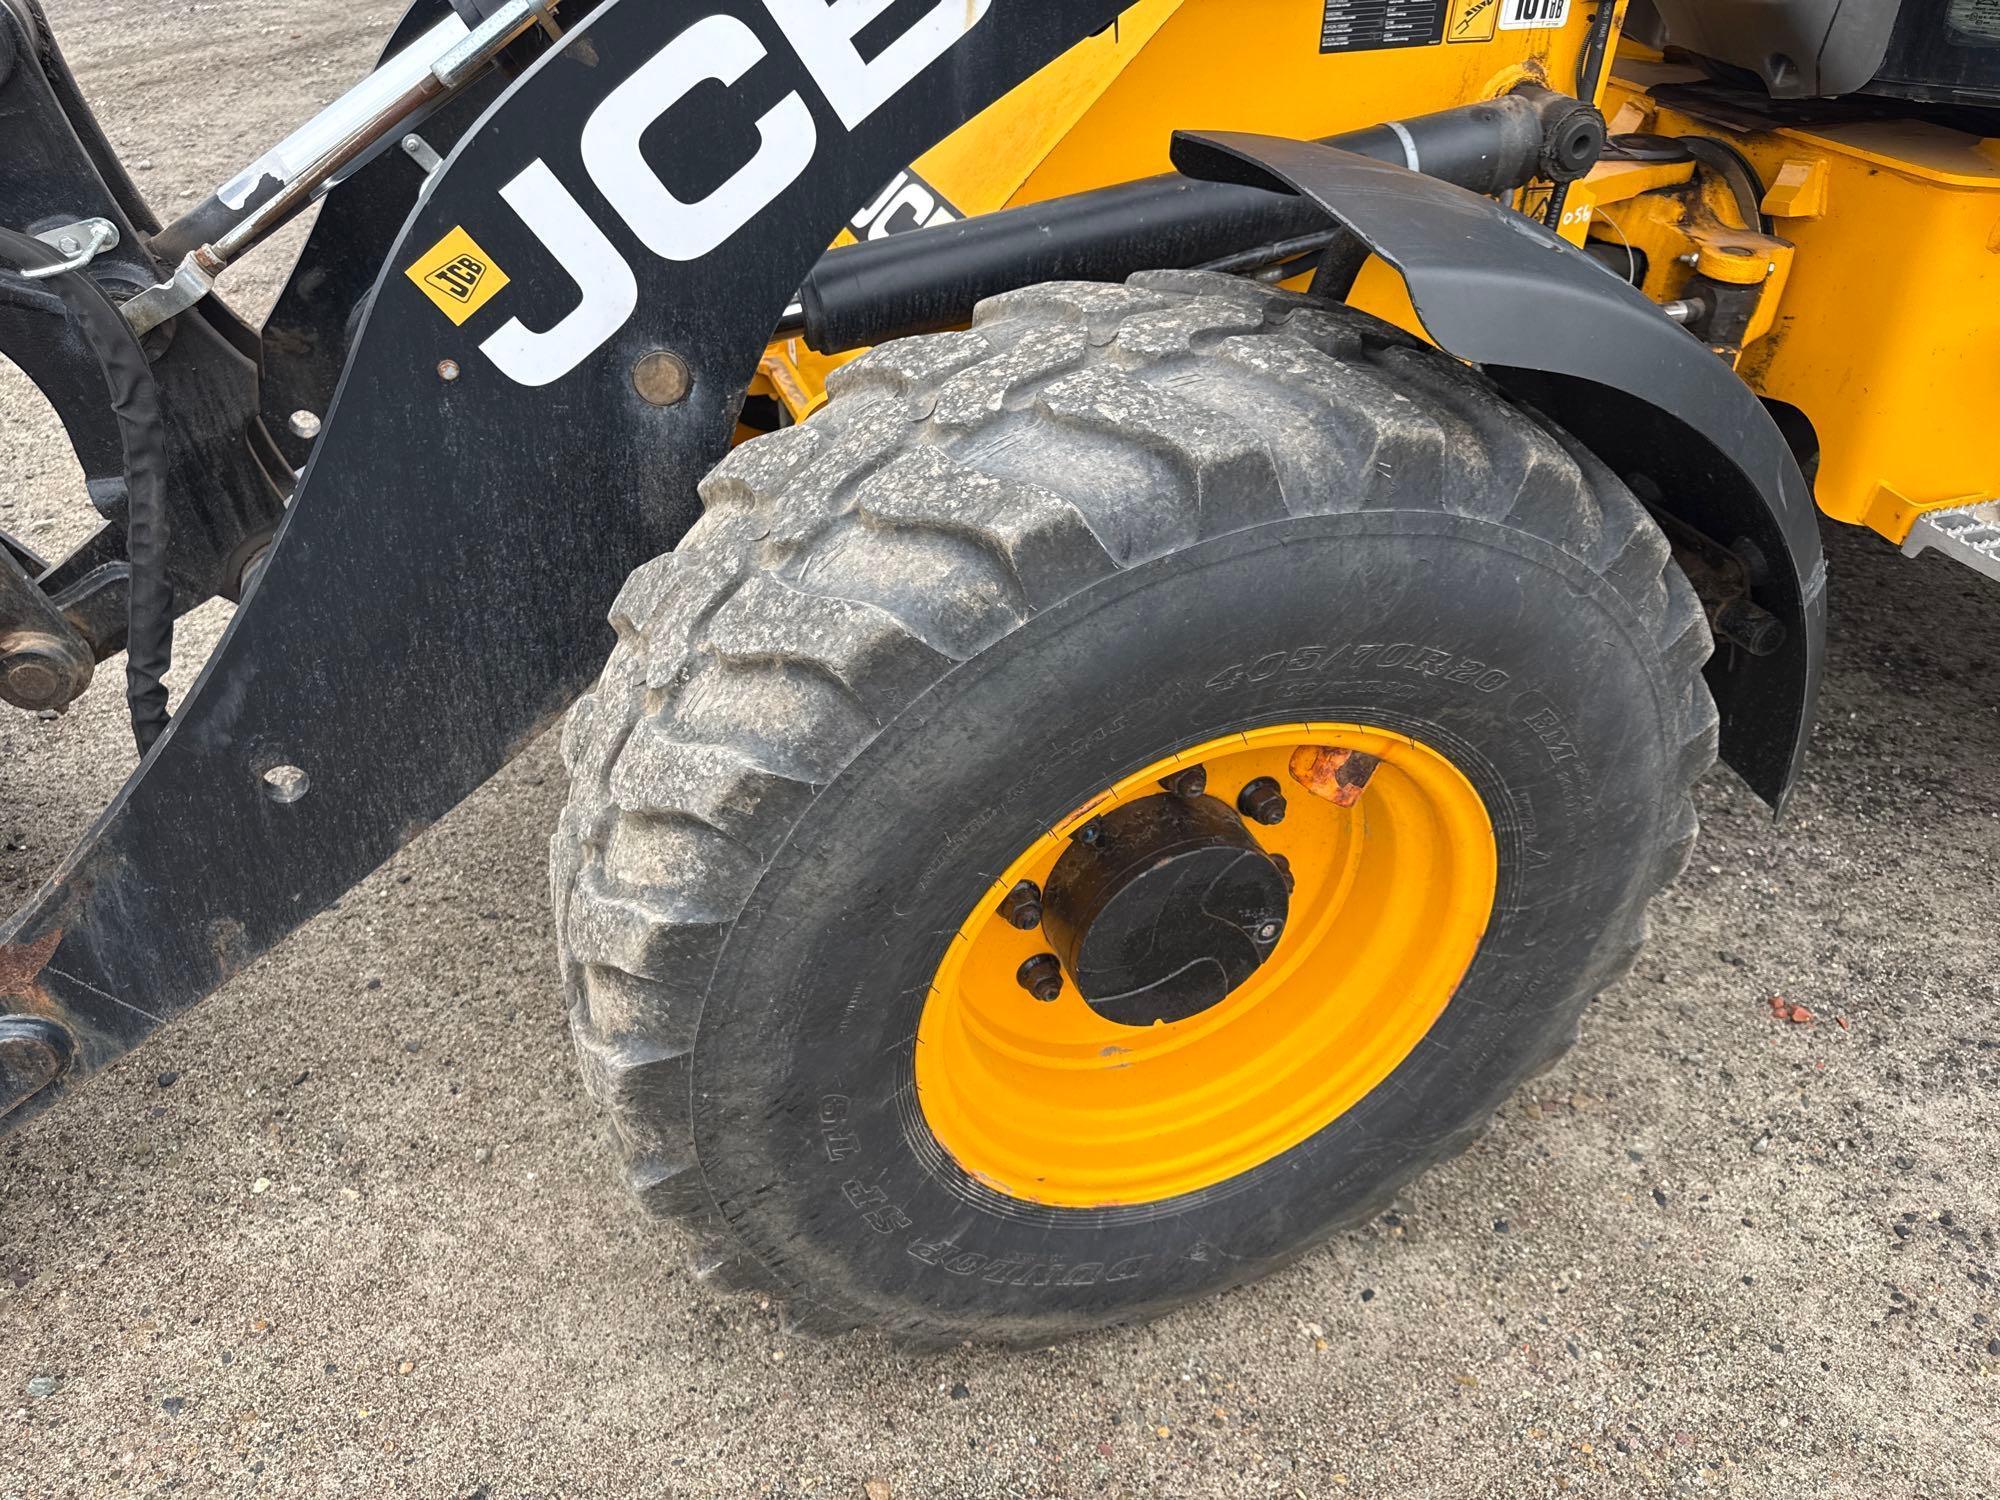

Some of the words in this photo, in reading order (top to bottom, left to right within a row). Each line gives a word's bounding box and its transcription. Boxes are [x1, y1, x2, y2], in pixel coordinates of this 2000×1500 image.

[850, 170, 956, 241] JC
[1563, 204, 1592, 226] 056
[435, 257, 483, 298] JCB
[1204, 642, 1510, 694] 405/70R20
[841, 1180, 913, 1234] SP
[906, 1240, 1153, 1286] DUNLOP
